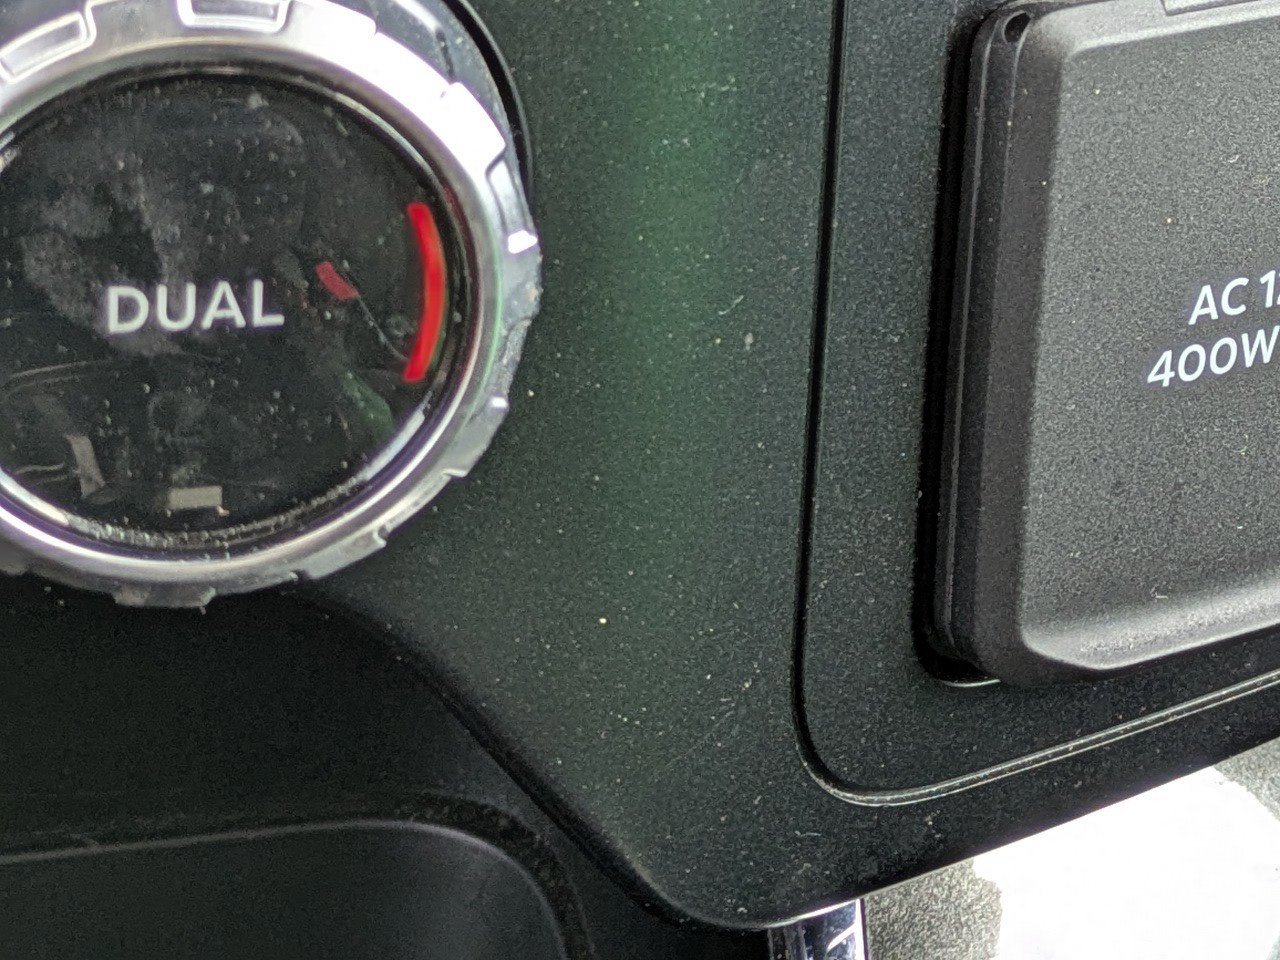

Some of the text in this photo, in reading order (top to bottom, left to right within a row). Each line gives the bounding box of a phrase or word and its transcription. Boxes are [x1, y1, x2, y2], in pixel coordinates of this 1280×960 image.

[107, 279, 285, 335] DUAL
[1188, 277, 1250, 326] AC
[1147, 325, 1280, 387] 400W
